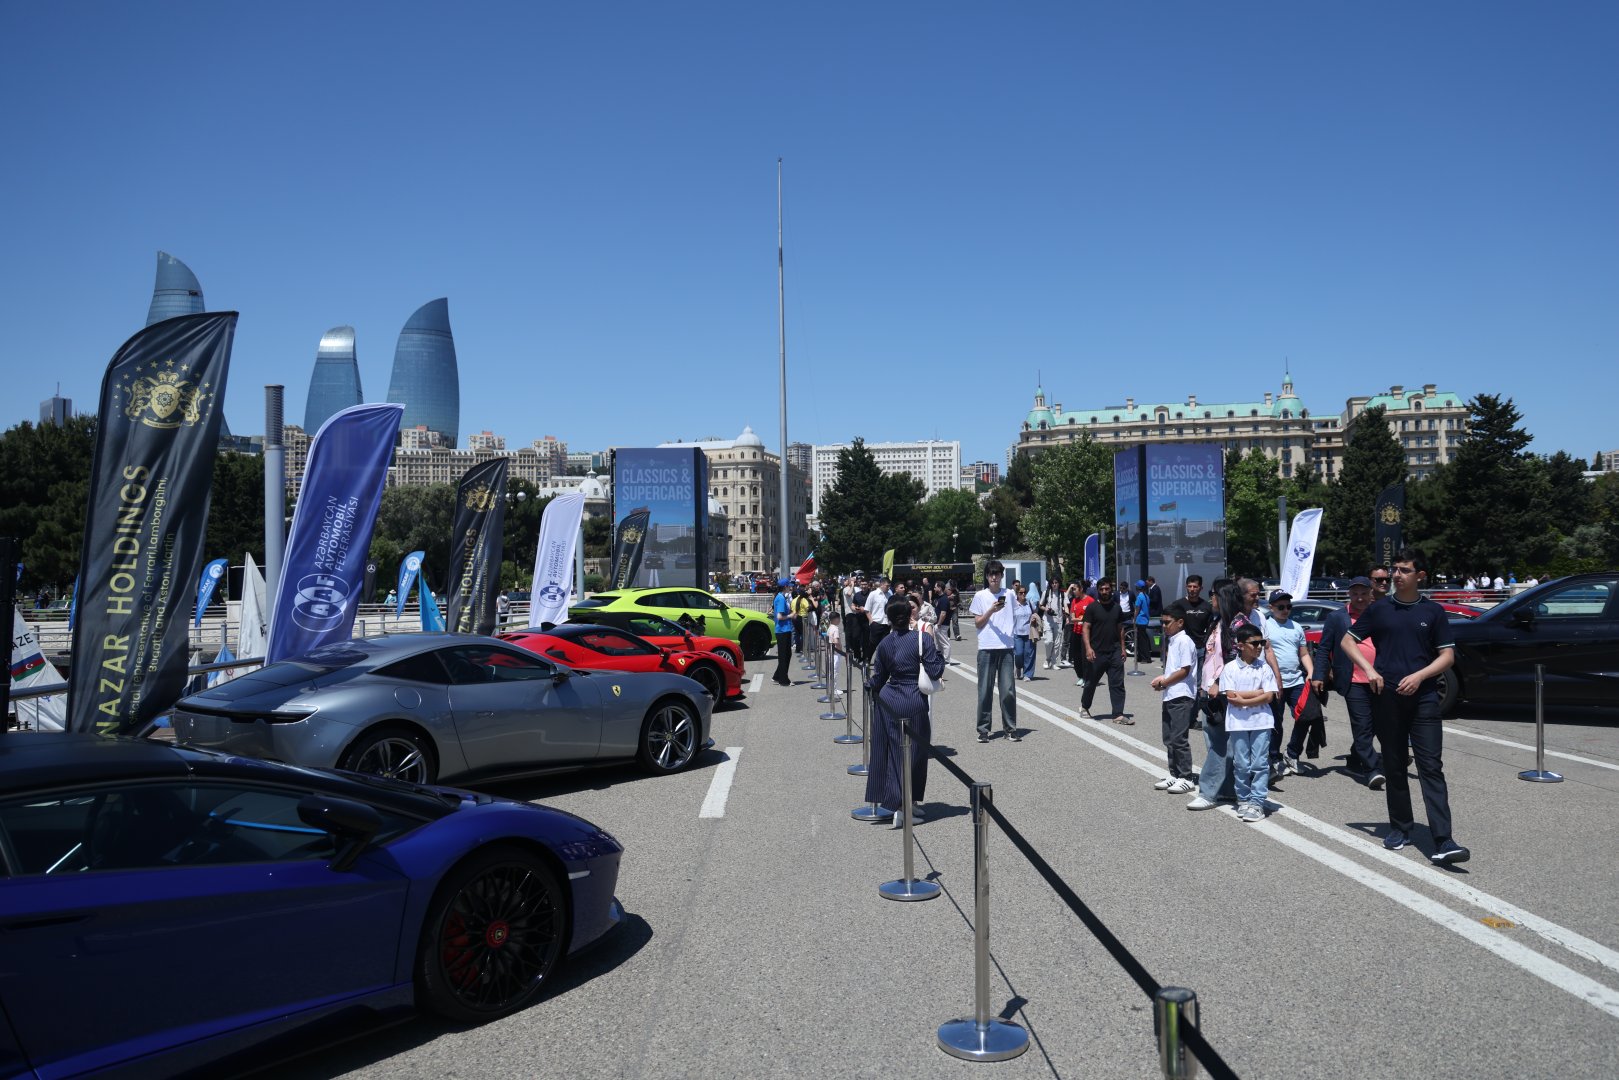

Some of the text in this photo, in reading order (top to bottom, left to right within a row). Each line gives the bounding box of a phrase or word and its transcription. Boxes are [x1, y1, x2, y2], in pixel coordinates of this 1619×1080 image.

[622, 468, 691, 484] CLASSICS &
[1151, 463, 1217, 480] CLASSICS &
[1151, 480, 1217, 496] SUPERCARS
[622, 485, 692, 501] SUPERCARS
[106, 465, 150, 614] HOLDINGS
[314, 495, 338, 570] AZƏRBAYCAN
[325, 503, 347, 571] AVTOMOBİL
[335, 496, 359, 572] FEDERASİYASI
[1383, 536, 1392, 567] DINGS
[461, 528, 477, 597] HOLDINGS
[617, 553, 628, 589] OLDINGS
[148, 533, 175, 673] Bugatti and Aston Martin
[311, 575, 335, 617] AAF
[132, 604, 152, 688] representative
[142, 589, 153, 602] of
[458, 605, 471, 633] ZAR
[11, 632, 34, 651] AZE
